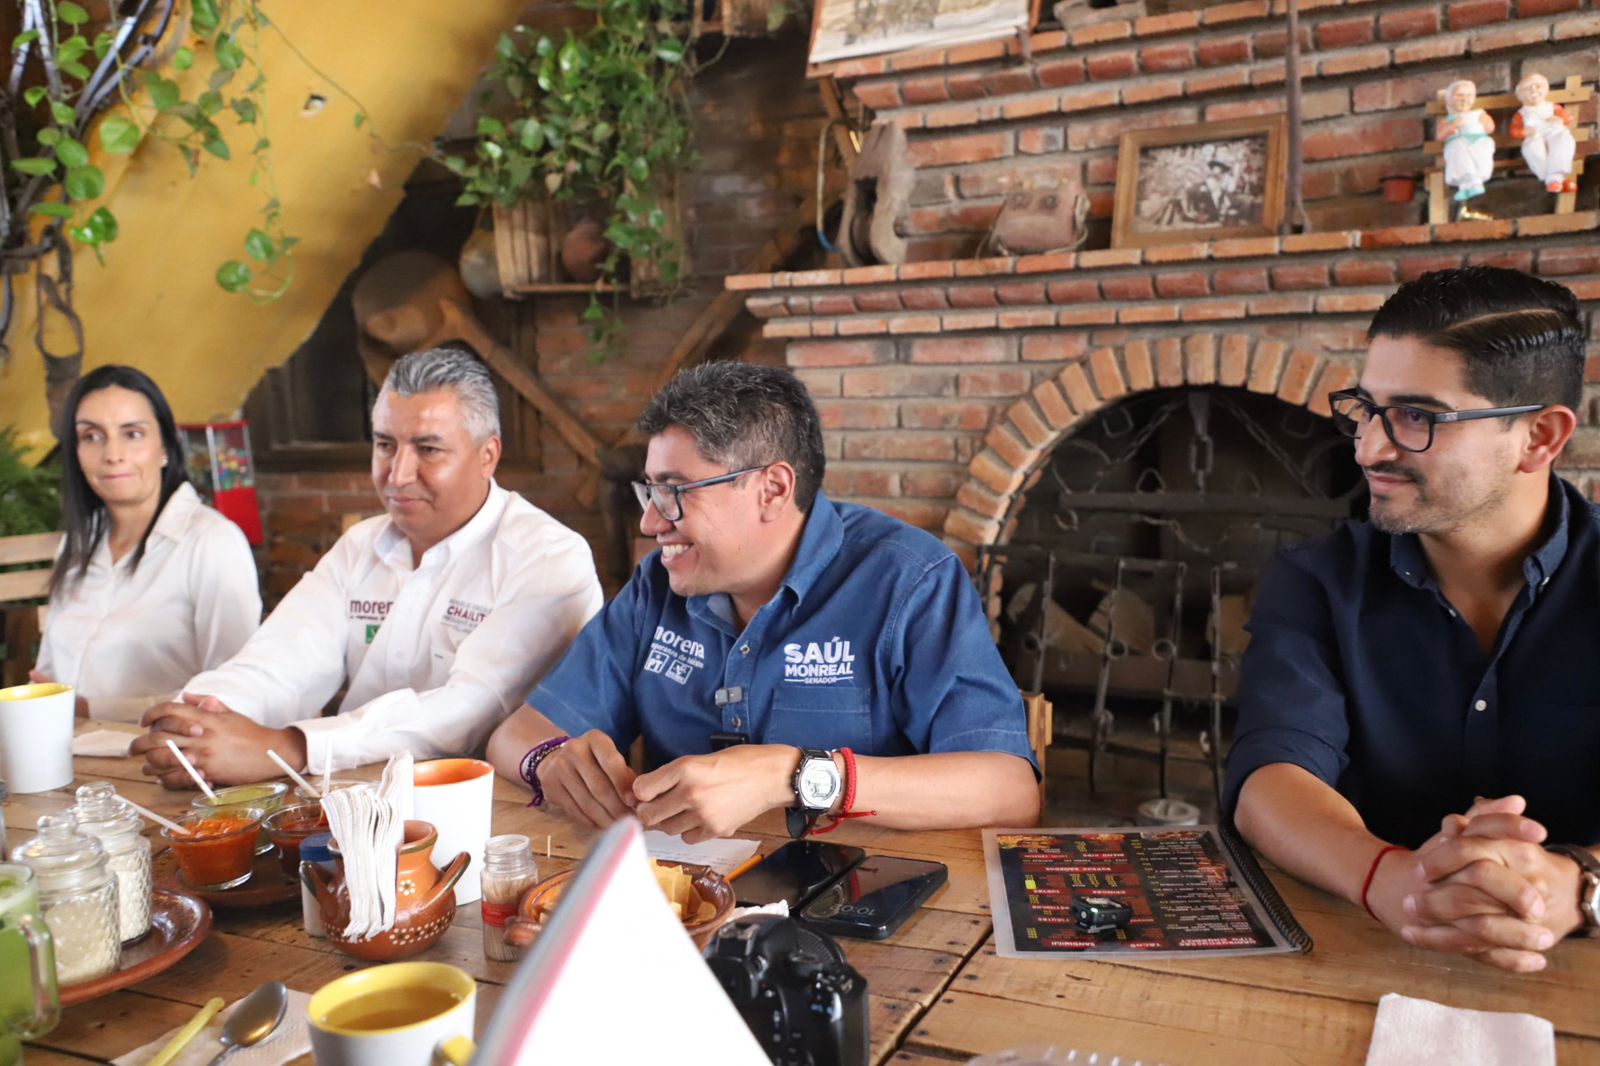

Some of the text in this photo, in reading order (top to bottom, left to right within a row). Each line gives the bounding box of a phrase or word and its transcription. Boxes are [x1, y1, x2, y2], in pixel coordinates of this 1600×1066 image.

[350, 600, 394, 615] moren
[784, 636, 855, 664] SAÚL
[785, 662, 853, 677] MONREAL
